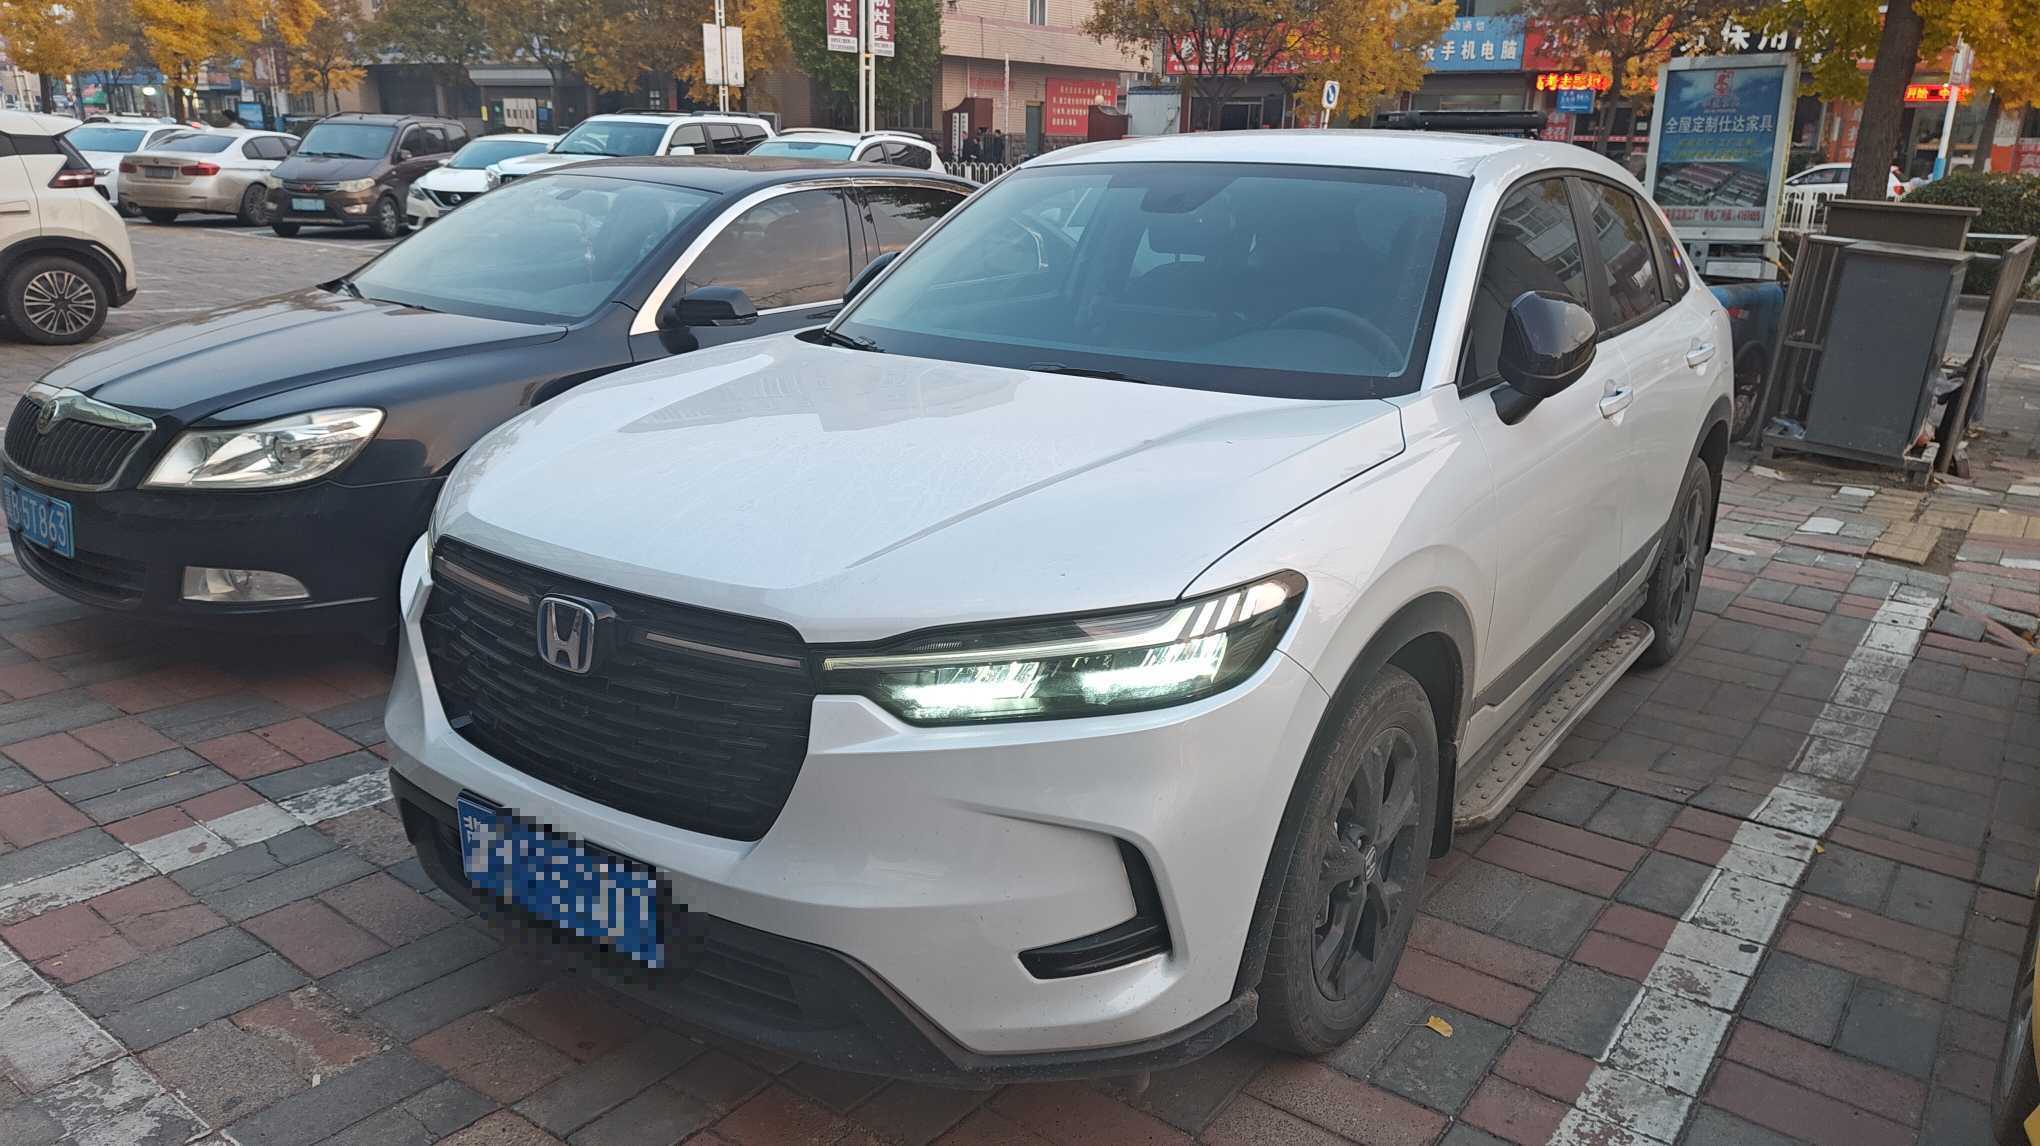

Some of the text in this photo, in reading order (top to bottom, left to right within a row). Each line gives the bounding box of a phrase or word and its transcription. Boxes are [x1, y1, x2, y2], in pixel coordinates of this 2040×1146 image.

[832, 0, 852, 35] 灶具
[1665, 113, 1774, 134] 全屋定制仕达家具
